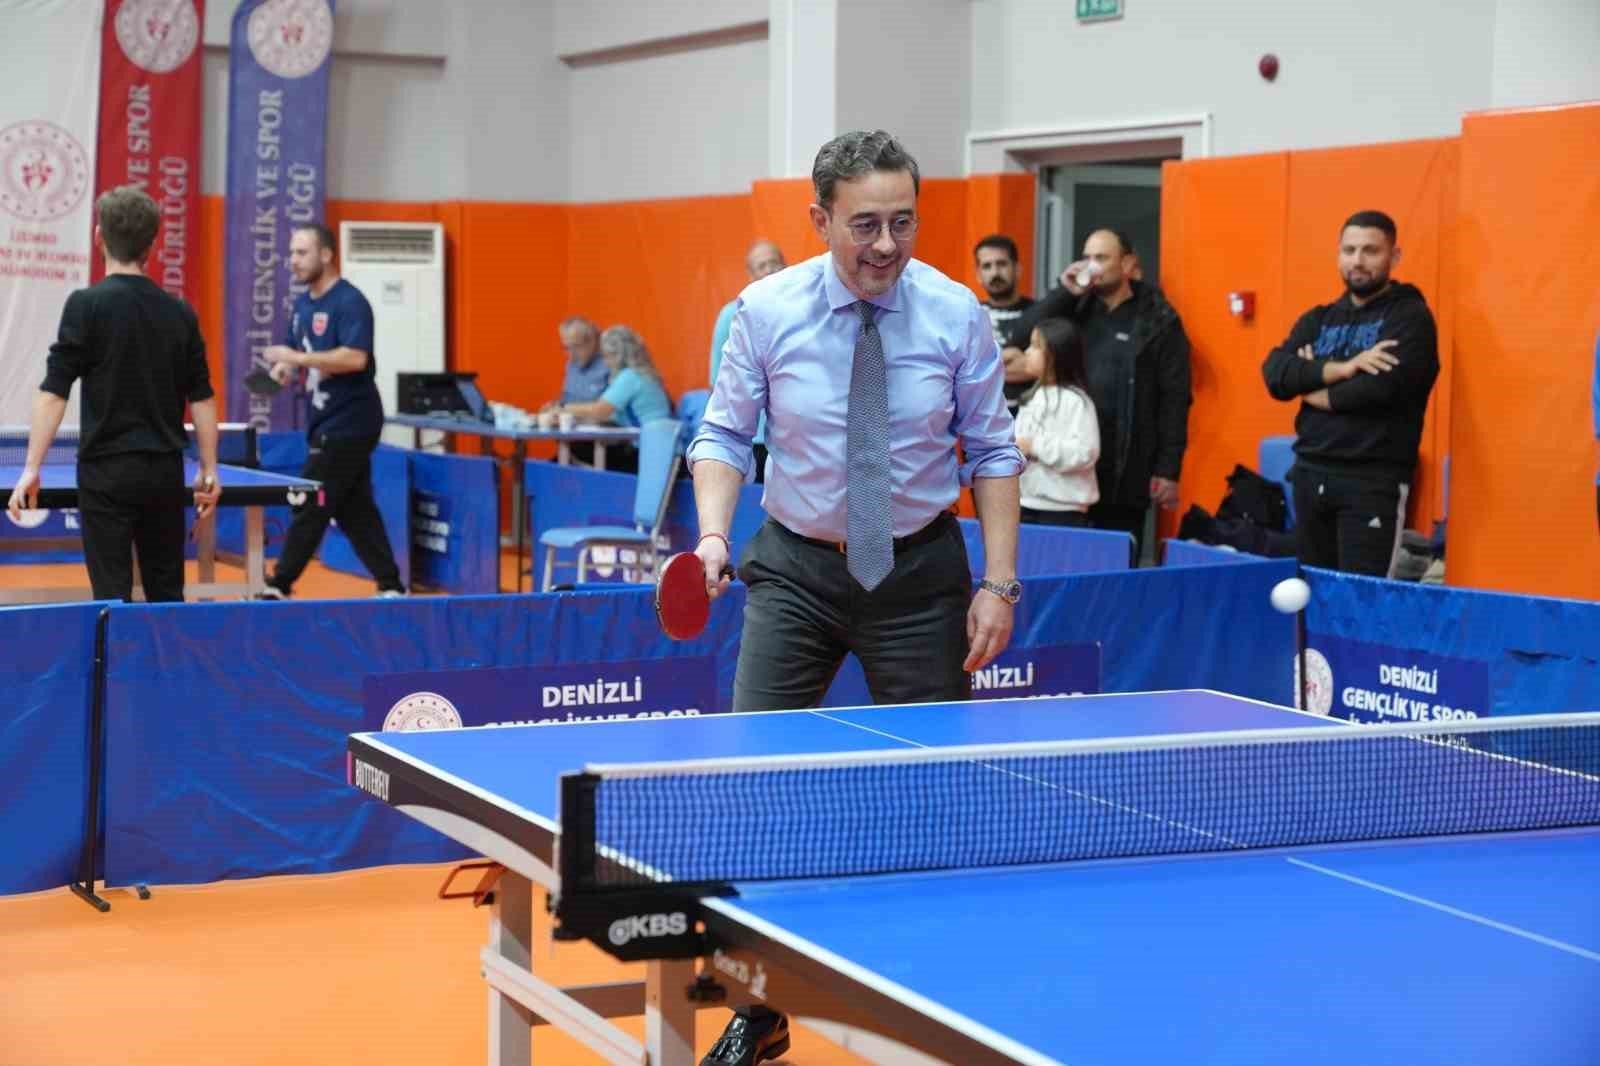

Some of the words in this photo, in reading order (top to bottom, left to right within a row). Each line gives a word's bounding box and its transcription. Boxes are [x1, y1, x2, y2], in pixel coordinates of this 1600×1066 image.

[127, 84, 151, 151] SPOR
[257, 90, 283, 160] SPOR
[256, 166, 279, 206] VE
[159, 156, 189, 300] DÜRLÜĞÜ
[250, 206, 279, 324] GENÇLİK
[246, 331, 272, 434] DEZLİ
[541, 676, 643, 708] DENİZLİ
[971, 661, 1034, 690] NİZLİ
[1379, 664, 1438, 694] DENİZLİ
[1342, 687, 1409, 719] GENÇLİK
[1409, 700, 1430, 721] VE
